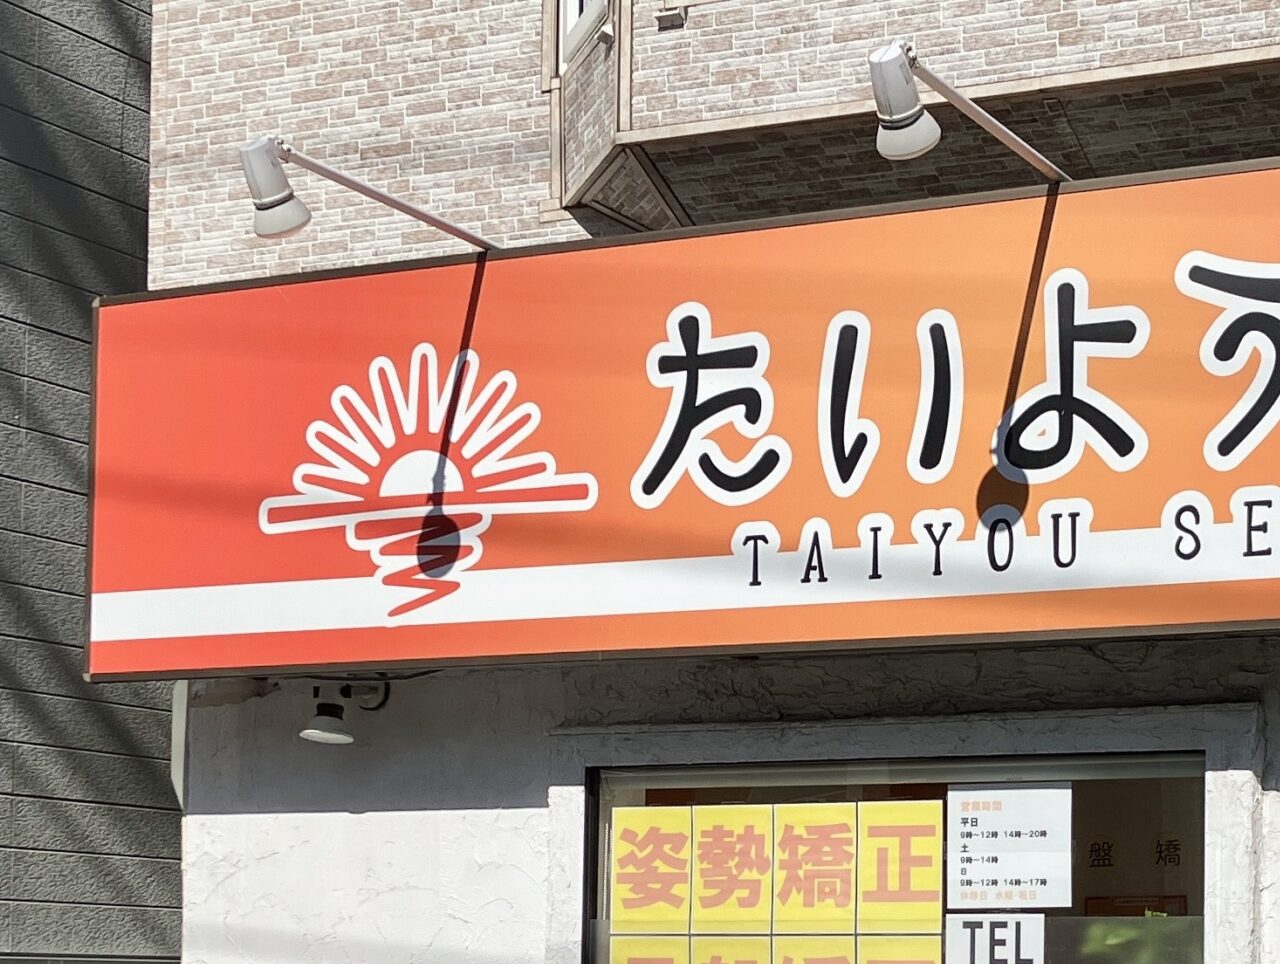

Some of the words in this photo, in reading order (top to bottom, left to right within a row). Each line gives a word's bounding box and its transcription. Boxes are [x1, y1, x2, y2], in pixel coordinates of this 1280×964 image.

[741, 511, 1081, 587] TAIYOU
[960, 817, 978, 827] 平日
[616, 823, 939, 909] 姿勢矯正
[960, 844, 969, 853] 土
